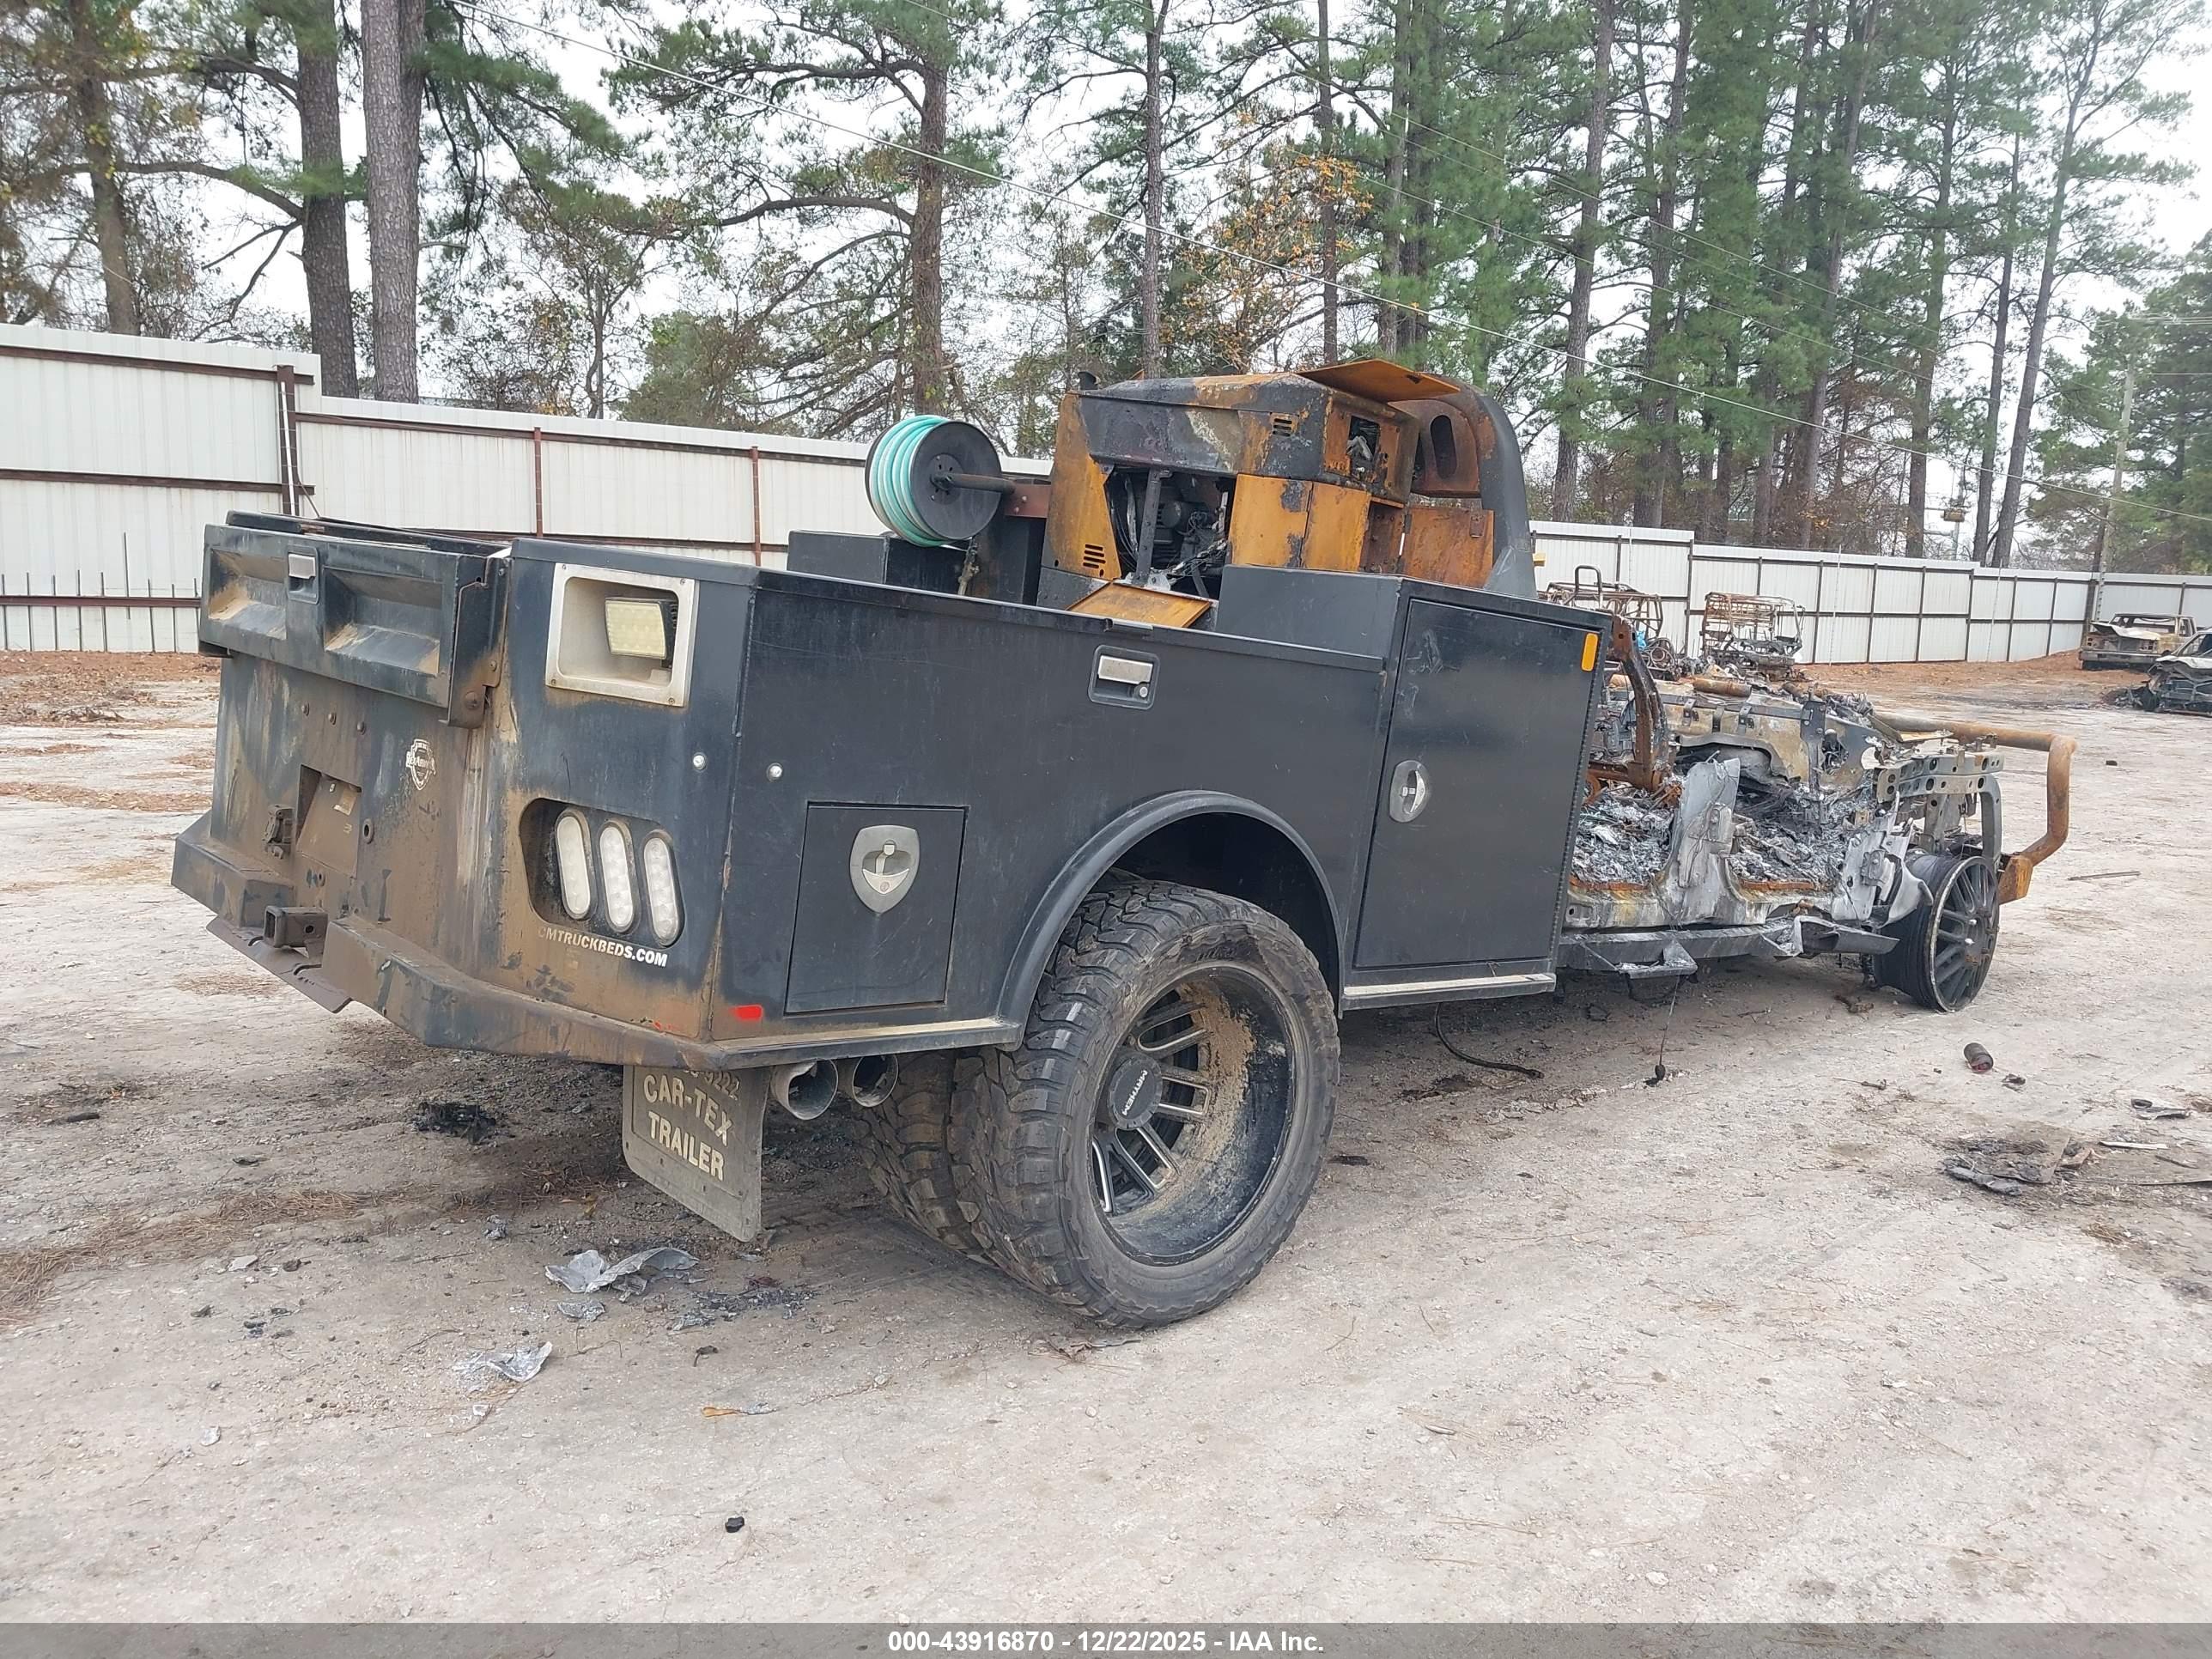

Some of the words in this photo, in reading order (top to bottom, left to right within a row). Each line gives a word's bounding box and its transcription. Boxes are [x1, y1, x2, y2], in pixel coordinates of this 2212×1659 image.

[538, 927, 669, 968] CMTRUCKBEDS.COM
[644, 1074, 733, 1147] CAR-TEX
[1121, 1069, 1148, 1116] MAYHEM
[647, 1110, 725, 1182] TRAILER
